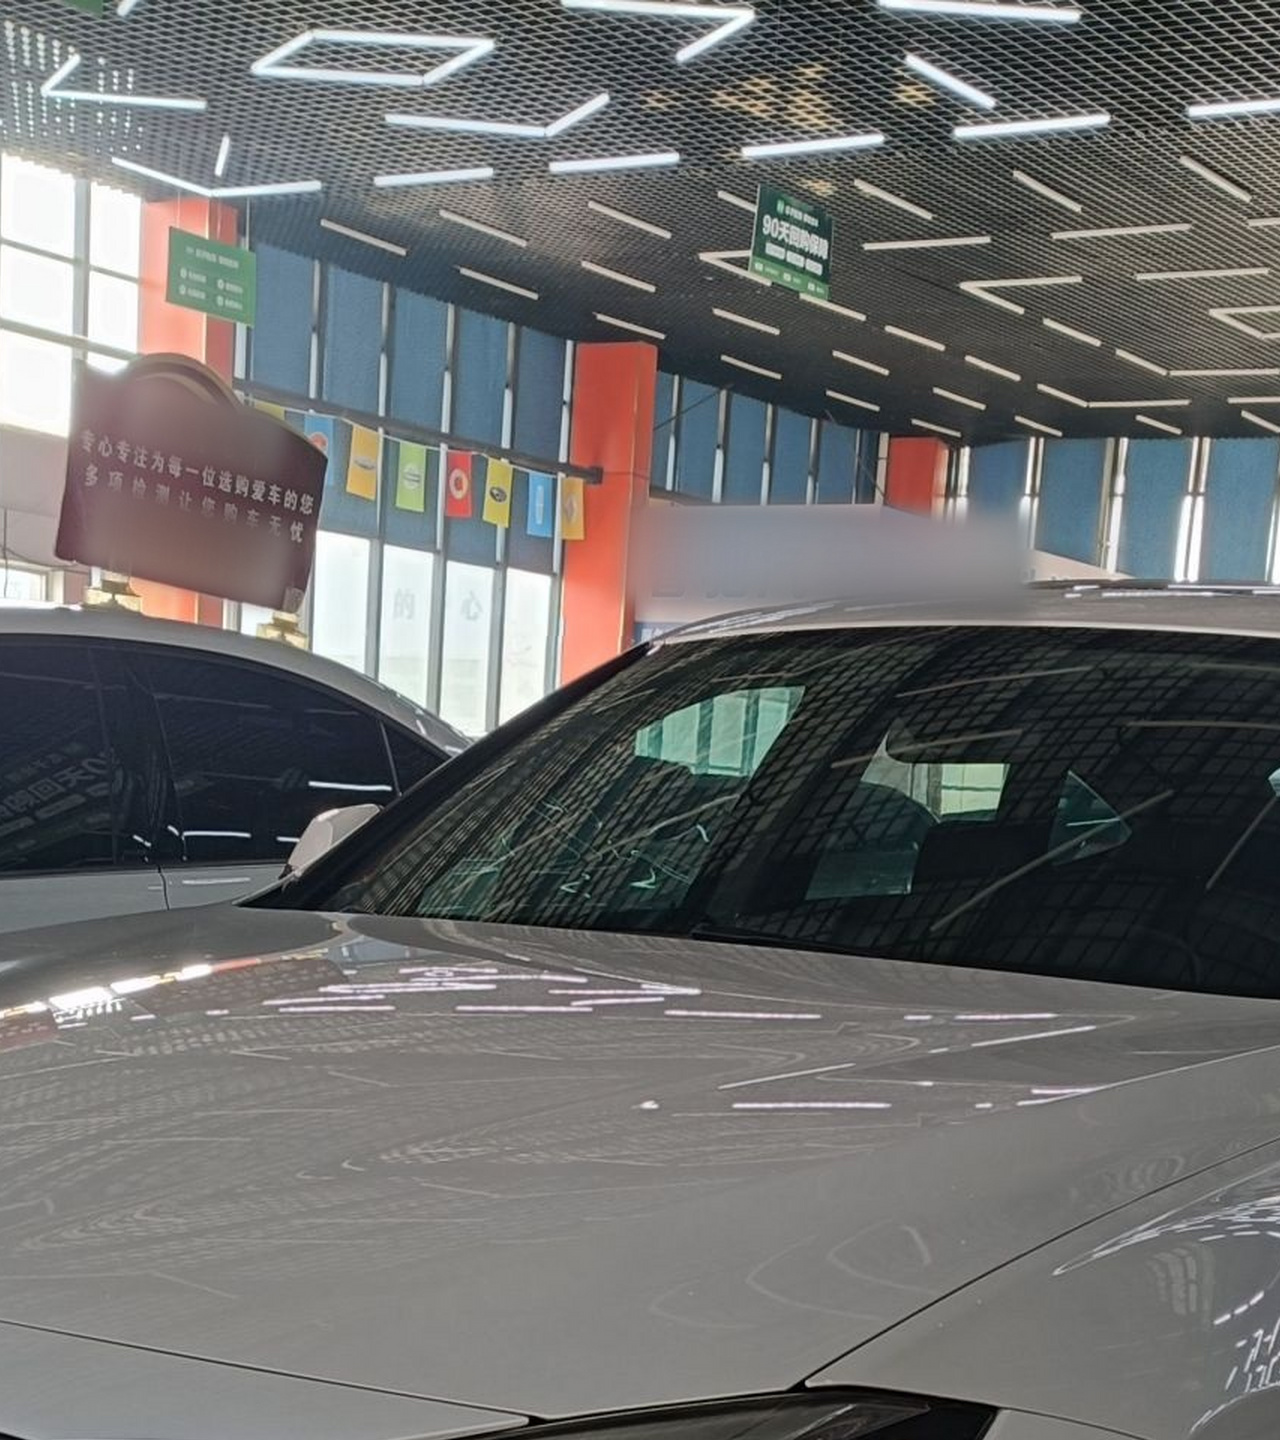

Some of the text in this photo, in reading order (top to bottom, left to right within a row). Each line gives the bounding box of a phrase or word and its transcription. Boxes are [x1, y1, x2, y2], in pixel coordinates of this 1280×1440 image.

[80, 429, 314, 515] 专心专注为每一位选购爱车的您
[84, 463, 304, 543] 多项检测让您购车无忧
